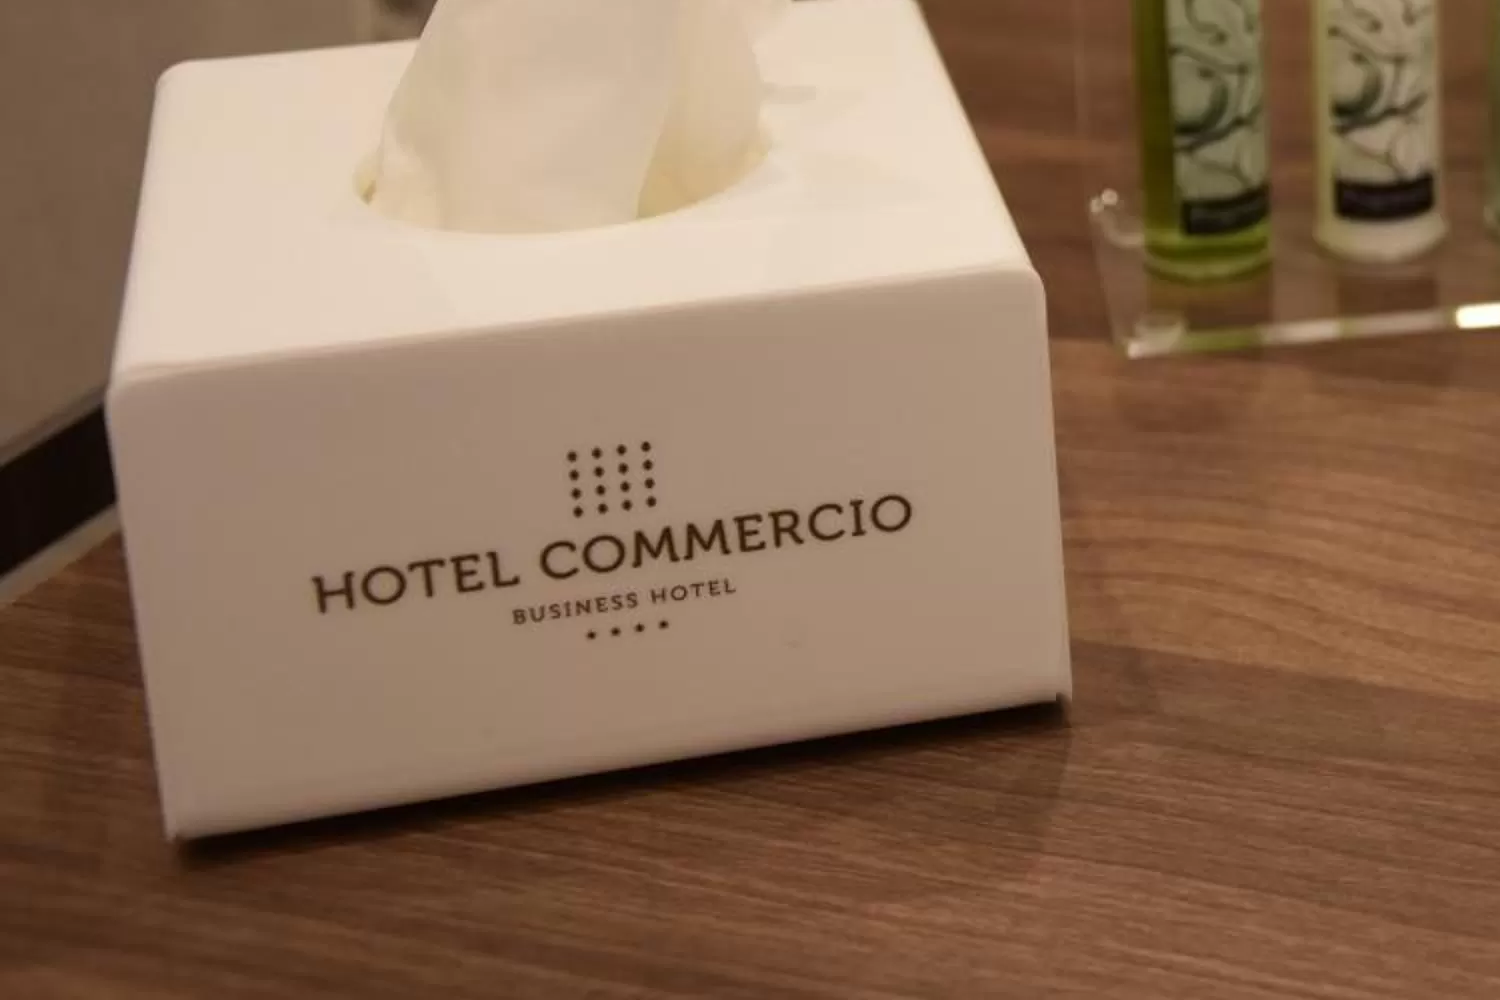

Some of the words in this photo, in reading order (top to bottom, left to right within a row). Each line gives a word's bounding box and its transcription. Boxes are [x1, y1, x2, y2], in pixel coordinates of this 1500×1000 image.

[313, 550, 520, 614] HOTEL
[539, 494, 913, 580] COMMERCIO
[512, 592, 640, 626] BUSINESS
[650, 577, 737, 605] HOTEL
